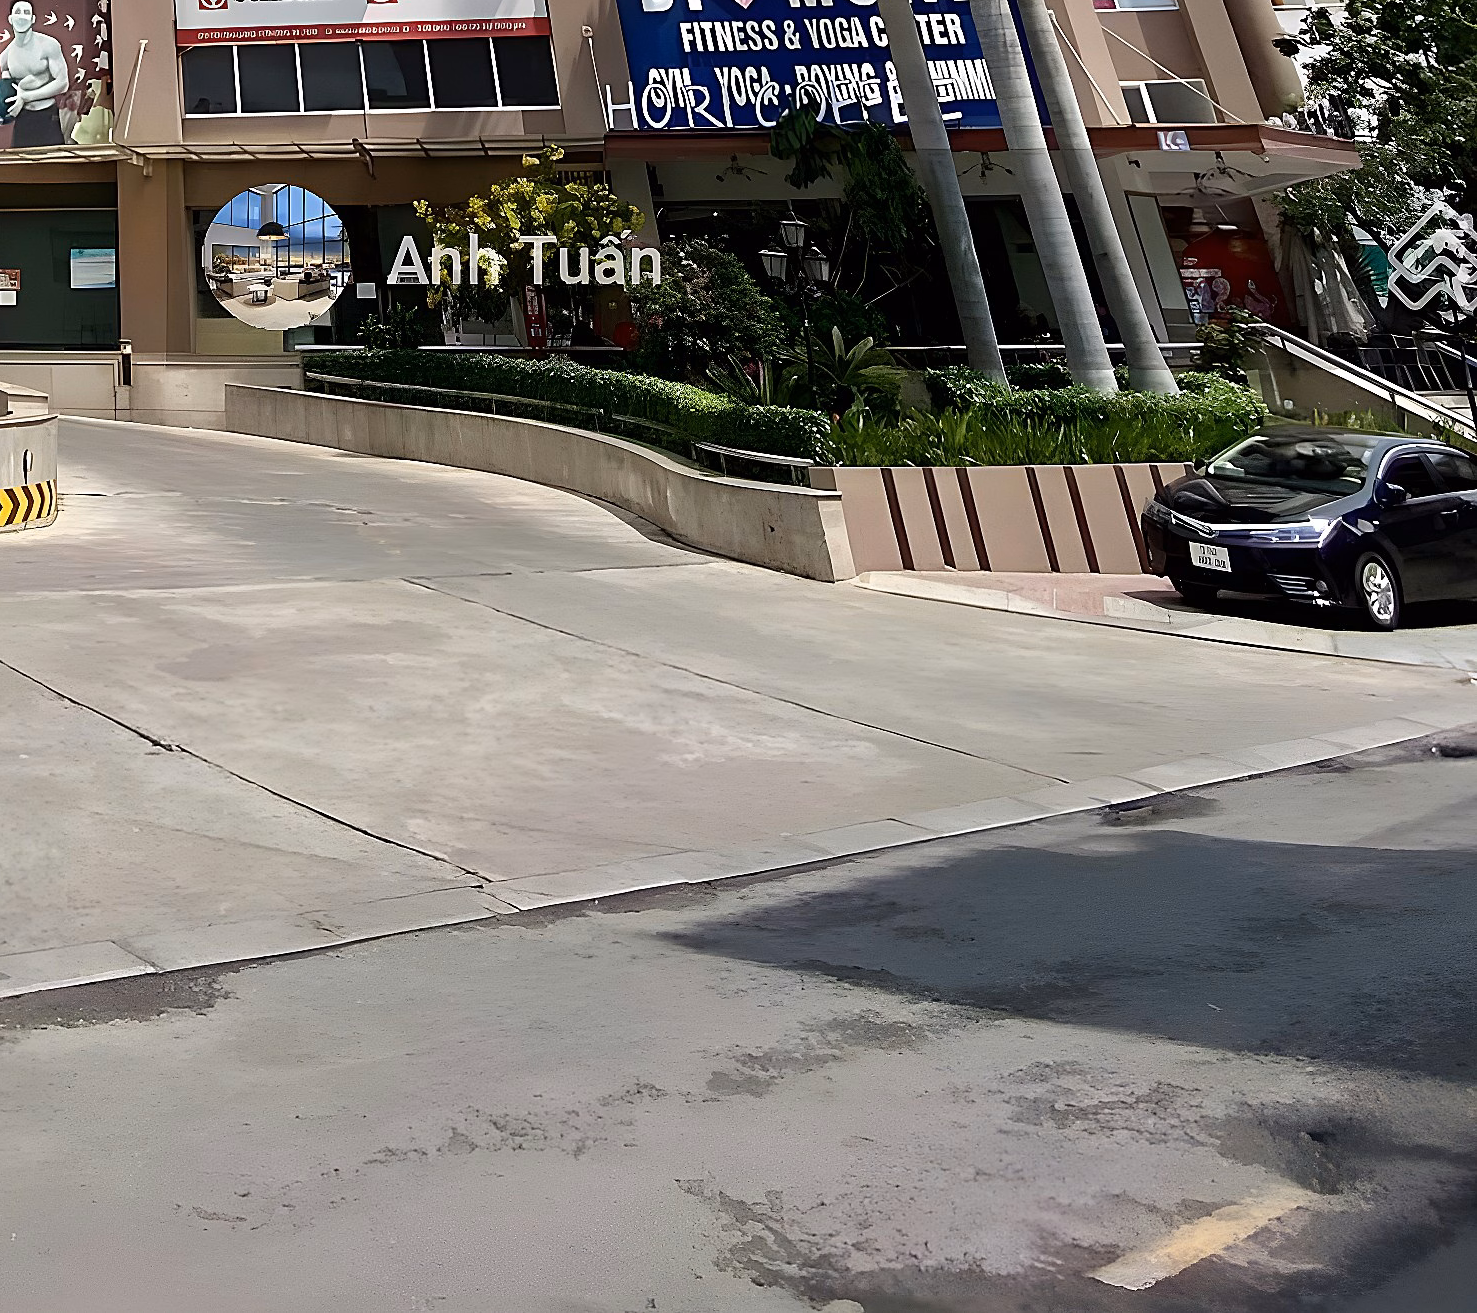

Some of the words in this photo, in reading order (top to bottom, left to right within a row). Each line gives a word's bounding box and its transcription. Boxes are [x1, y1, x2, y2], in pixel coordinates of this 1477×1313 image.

[680, 19, 779, 53] FITNESS
[784, 19, 802, 50] &
[804, 16, 869, 49] YOGA
[869, 13, 966, 49] CTER
